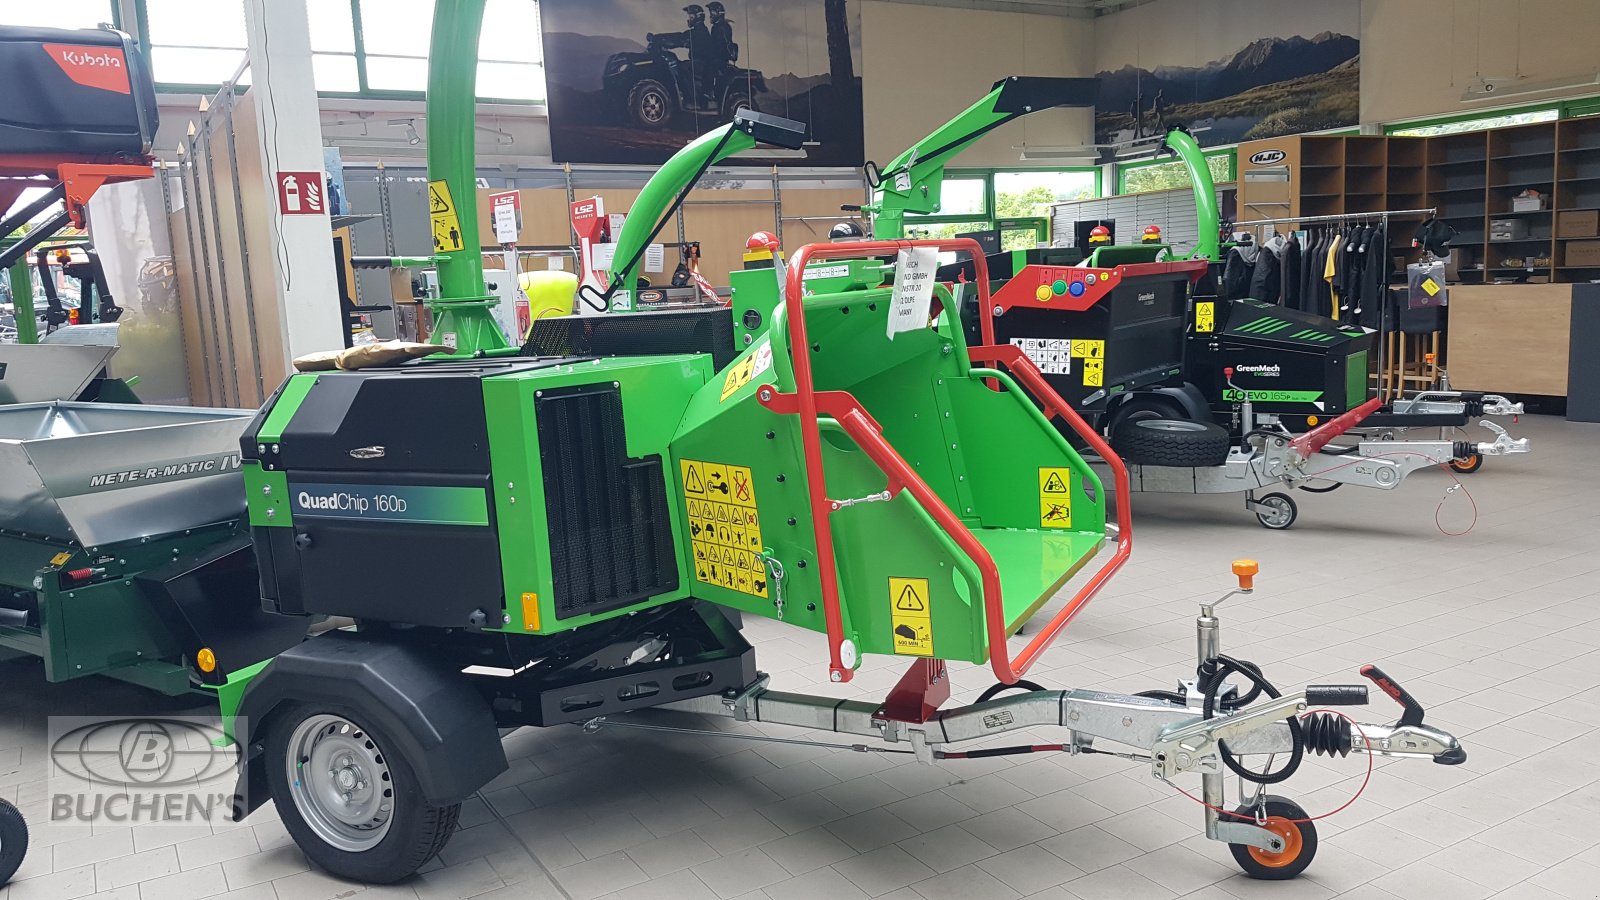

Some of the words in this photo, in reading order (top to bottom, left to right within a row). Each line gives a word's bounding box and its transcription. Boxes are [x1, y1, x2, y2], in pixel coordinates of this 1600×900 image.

[63, 51, 120, 67] Kubota
[1254, 152, 1281, 162] HJC
[575, 204, 594, 214] LS2
[1236, 364, 1280, 372] GreenMech
[1226, 389, 1246, 401] 40
[1247, 392, 1268, 400] EVO
[89, 460, 215, 487] METE-R-MATIC
[298, 492, 369, 514] QuadChip
[373, 495, 407, 512] 160D
